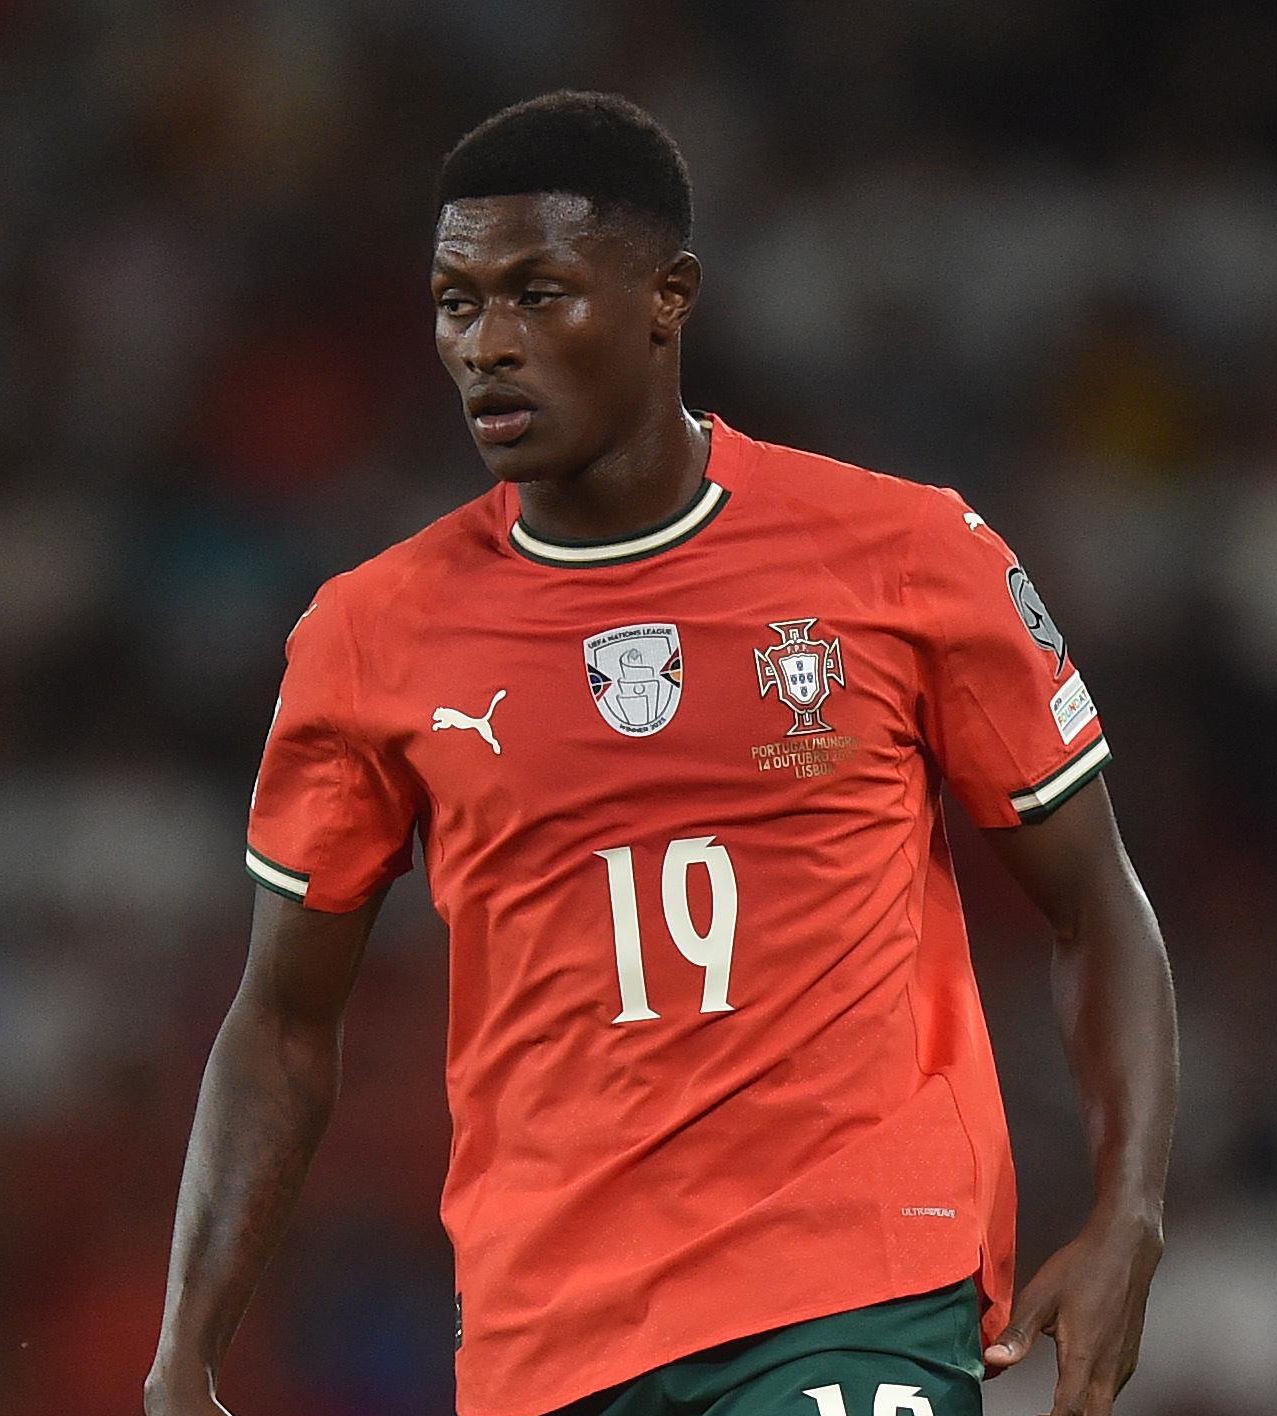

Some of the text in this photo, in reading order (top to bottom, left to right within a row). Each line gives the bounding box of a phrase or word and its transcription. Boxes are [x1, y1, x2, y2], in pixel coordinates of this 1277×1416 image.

[588, 637, 606, 649] UEFA
[608, 629, 641, 641] NATIONS
[758, 759, 771, 772] 14
[773, 750, 829, 769] OUTUBRO
[593, 835, 738, 1024] 19
